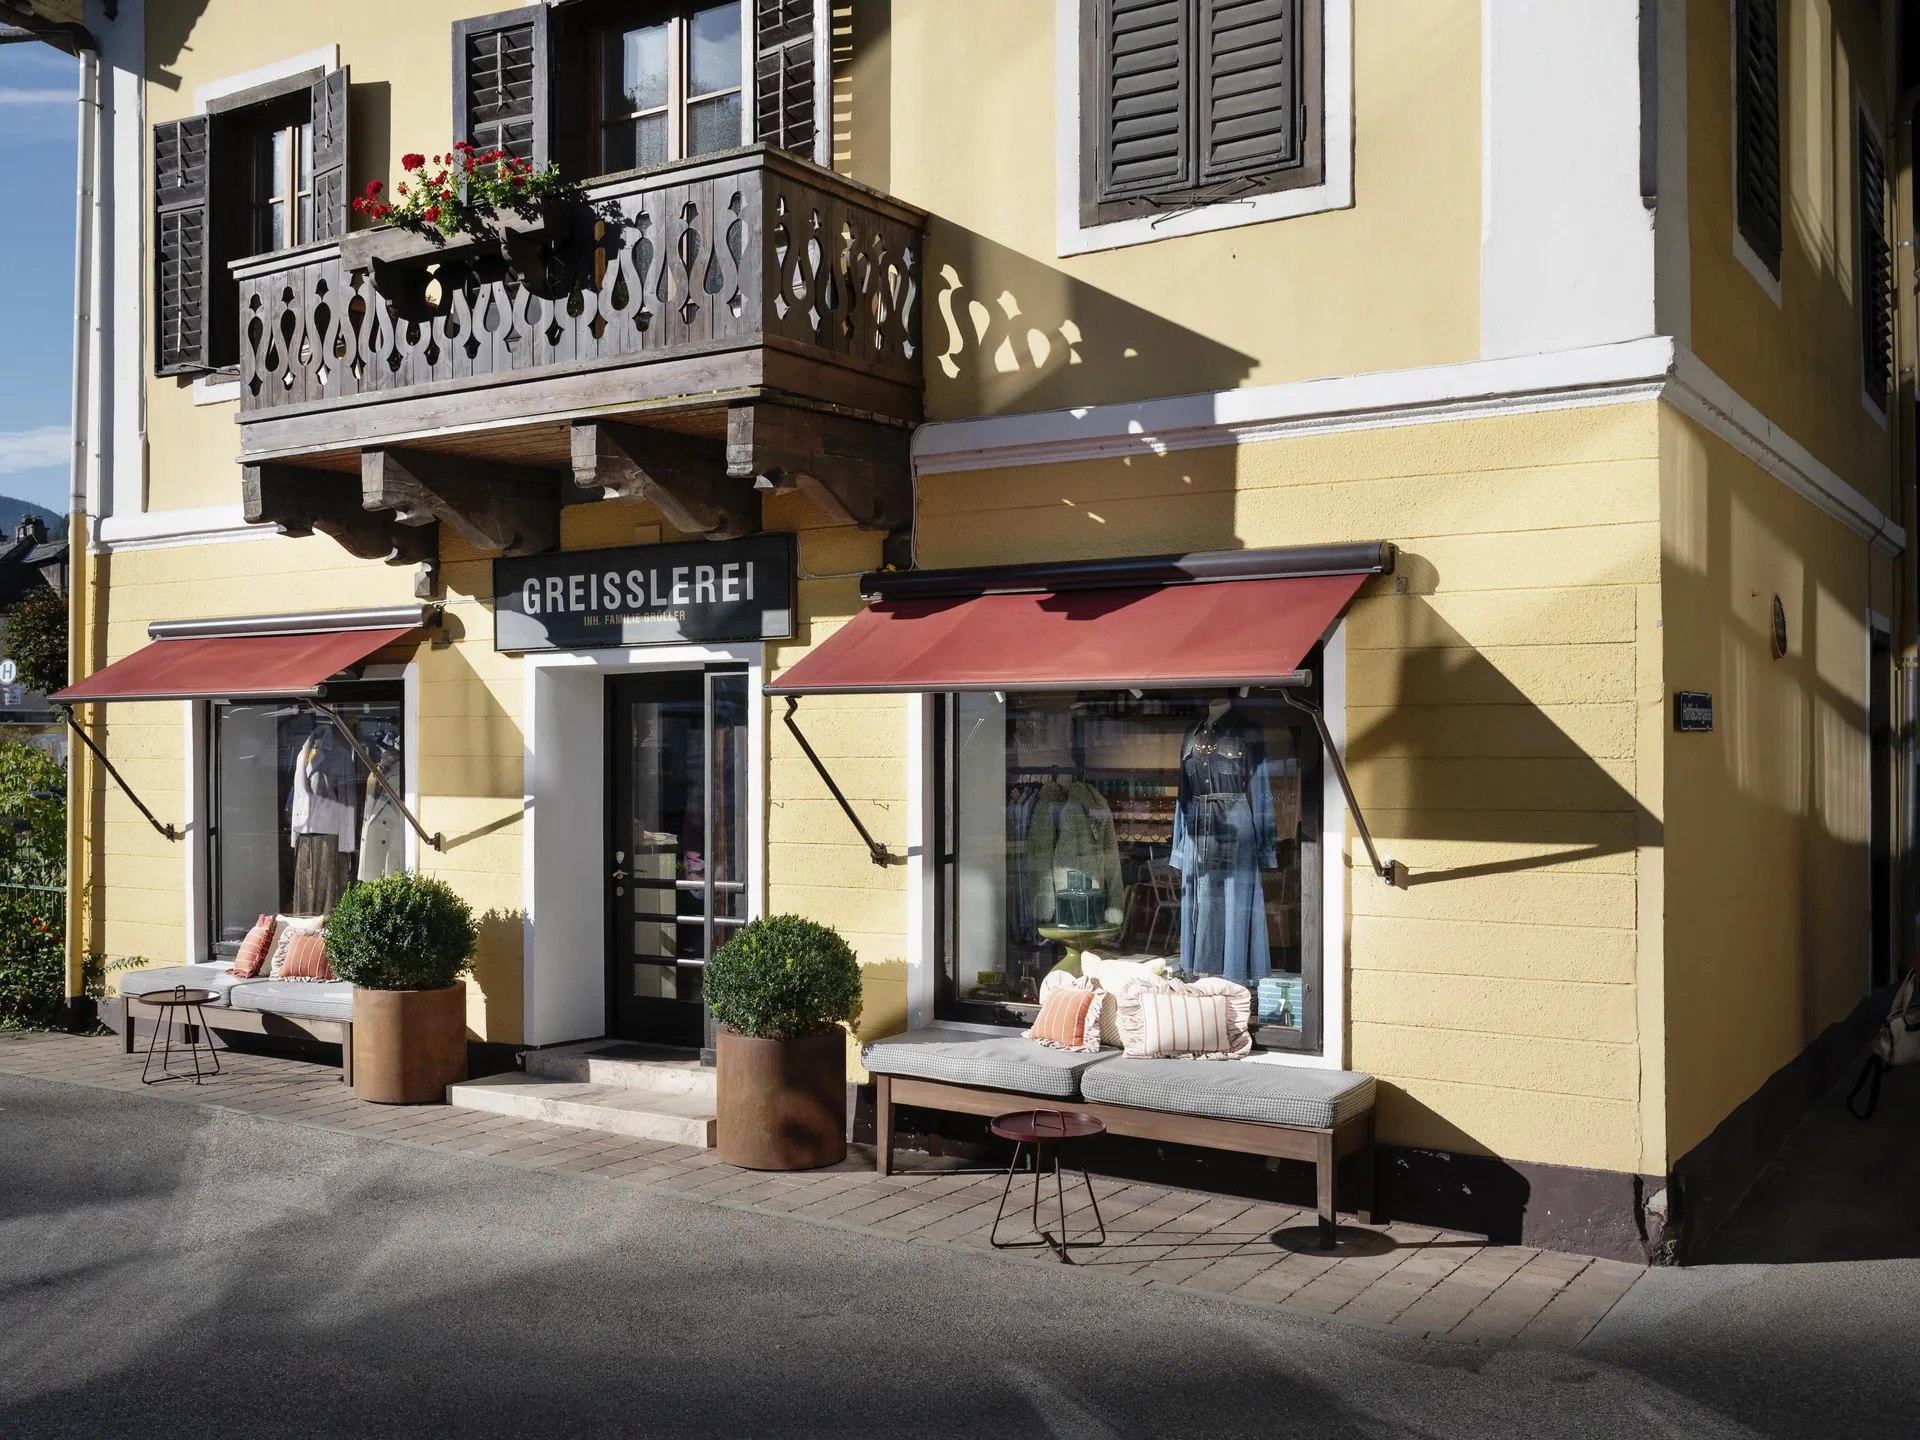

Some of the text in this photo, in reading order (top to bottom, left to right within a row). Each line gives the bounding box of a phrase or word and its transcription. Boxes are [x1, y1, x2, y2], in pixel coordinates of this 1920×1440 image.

[522, 561, 754, 615] GREISSLEREI
[584, 609, 686, 626] INH. FAMILIE GRÖLLER
[2, 663, 13, 679] H
